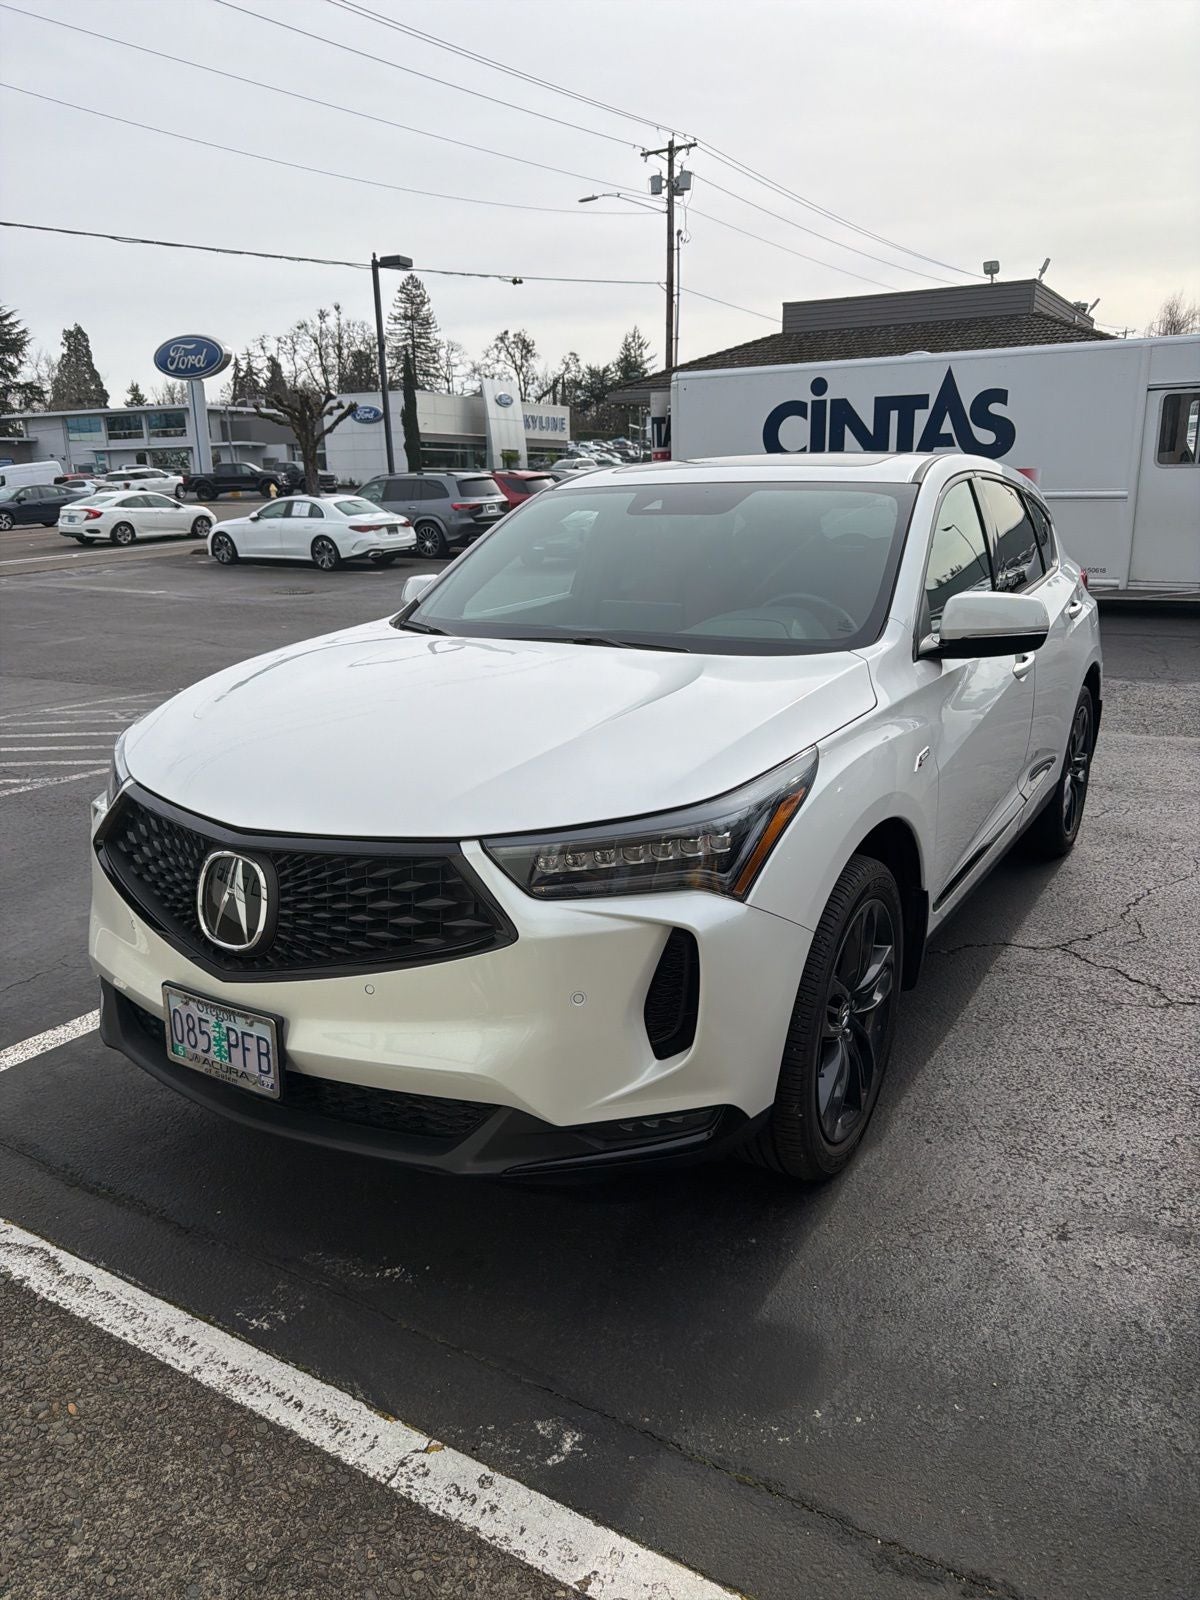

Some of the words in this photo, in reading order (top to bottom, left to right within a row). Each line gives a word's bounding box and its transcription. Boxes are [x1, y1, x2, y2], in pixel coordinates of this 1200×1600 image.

[167, 344, 207, 370] Ford
[355, 408, 376, 420] Ford
[172, 1008, 211, 1054] 085
[226, 1025, 271, 1075] PFB
[177, 1047, 185, 1056] 5
[202, 1058, 251, 1082] ACURA
[215, 1069, 238, 1084] Salem
